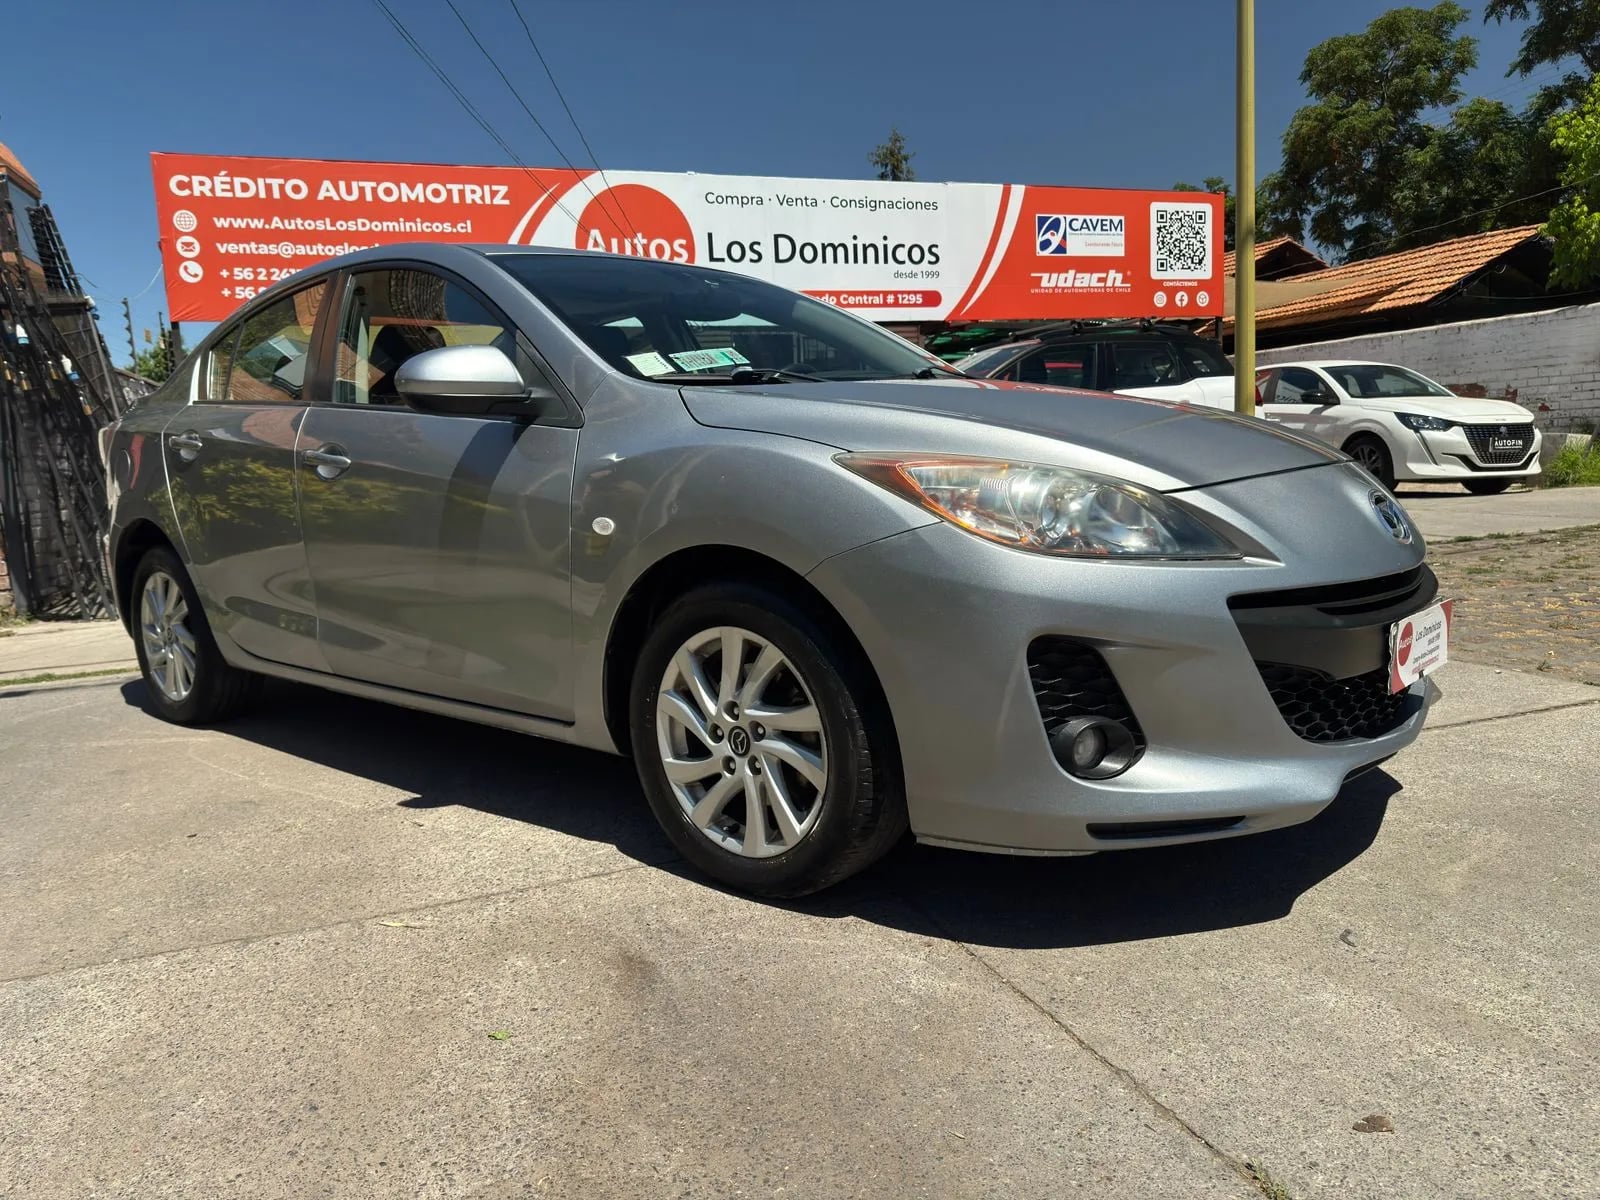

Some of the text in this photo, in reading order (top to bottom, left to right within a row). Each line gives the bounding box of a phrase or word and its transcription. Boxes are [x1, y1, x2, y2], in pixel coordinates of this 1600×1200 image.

[169, 171, 510, 205] CRÉDITO AUTOMOTRIZ
[704, 192, 939, 211] Compra Venta Consignaciones
[213, 216, 472, 233] www.AutosLosDominicos.cl
[1068, 217, 1123, 232] CAVEM
[587, 229, 689, 262] Autos
[707, 232, 940, 265] Los Dominicos
[233, 267, 254, 280] 56
[256, 267, 268, 280] 2
[893, 270, 940, 280] desde 1999
[1030, 269, 1131, 287] udach
[235, 286, 255, 299] 56
[815, 293, 923, 305] do Central # 1295
[1494, 438, 1523, 447] AUTOFIN
